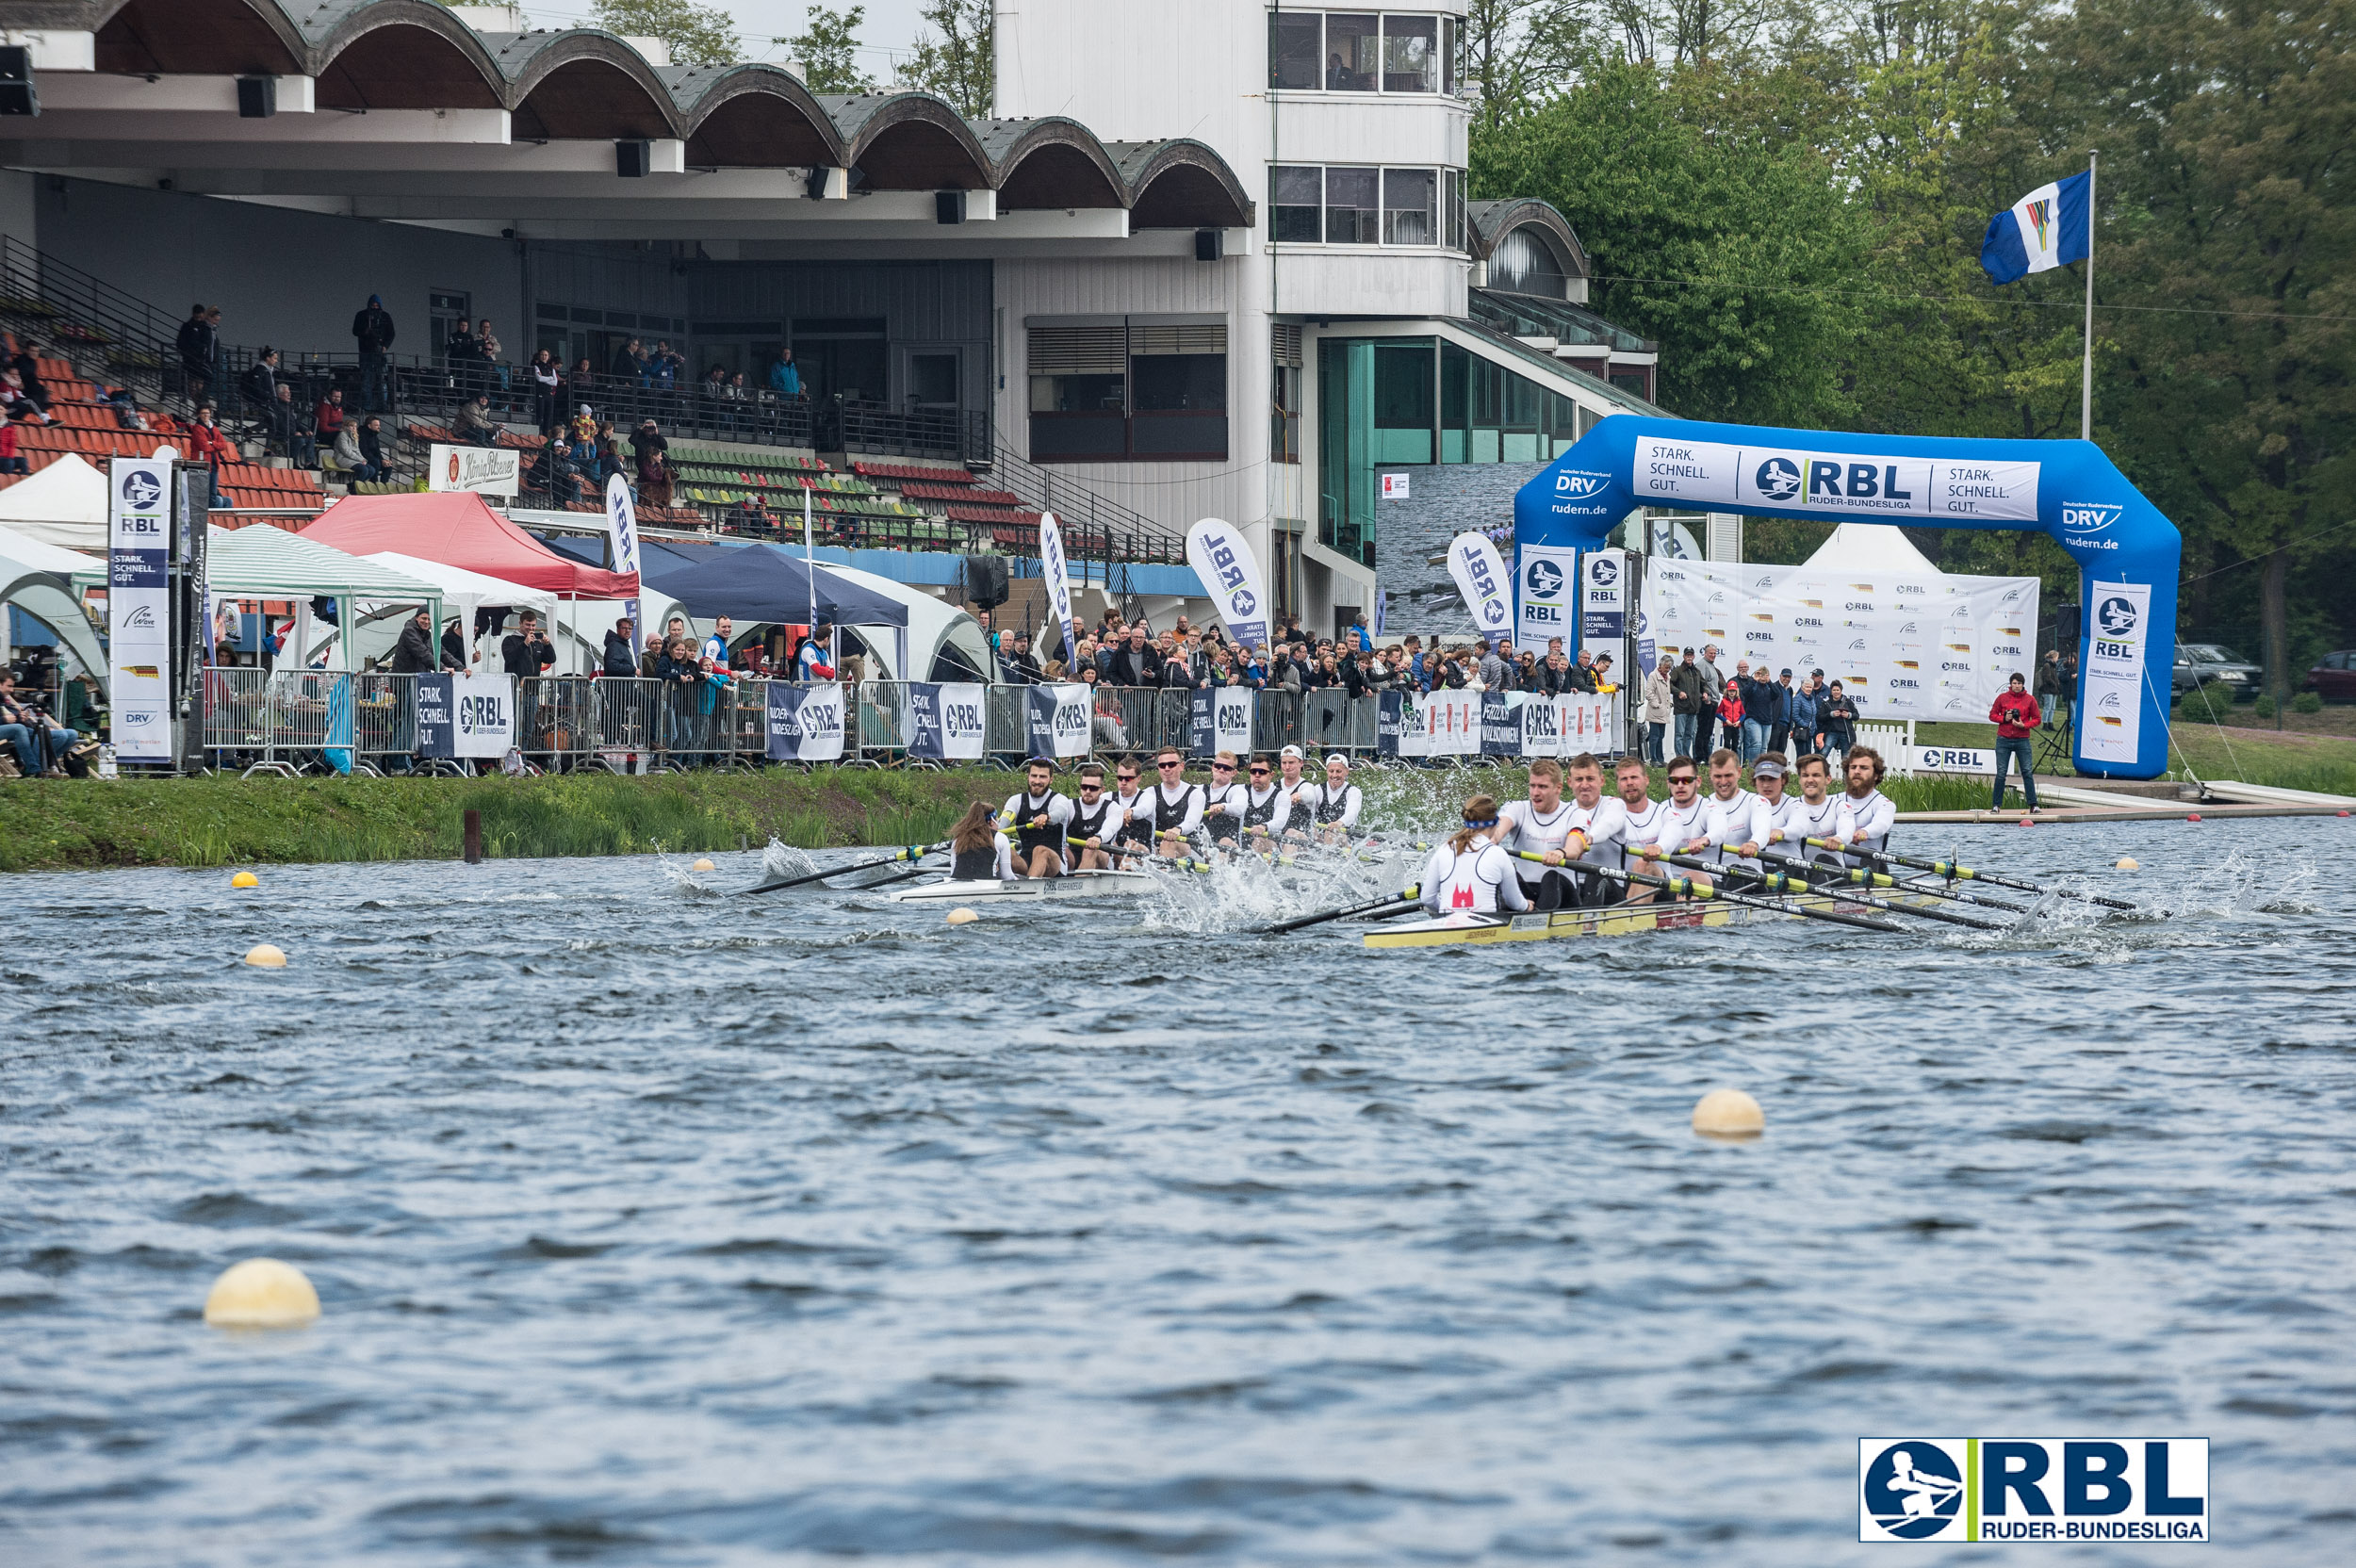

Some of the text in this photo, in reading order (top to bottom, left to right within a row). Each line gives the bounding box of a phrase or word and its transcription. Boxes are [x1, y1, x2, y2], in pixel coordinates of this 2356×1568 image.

[1652, 447, 1694, 461] STARK.
[1650, 463, 1710, 479] SCHNELL.
[1949, 468, 1993, 482] STARK.
[1556, 476, 1596, 494] DRV
[1650, 479, 1679, 492] GUT.
[1809, 461, 1911, 499] RBL
[1948, 484, 2009, 498] SCHNELL.
[1552, 503, 1608, 515] rudern.de
[1809, 497, 1911, 510] RUDER-BUNDESLIGA
[1948, 501, 1979, 514] GUT.
[2063, 509, 2107, 526] DRV
[122, 518, 160, 532] RBL
[2066, 537, 2119, 549] rudern.de
[115, 555, 145, 564] STARK.
[115, 564, 155, 573] SCHNELL.
[1591, 592, 1616, 600] RBL
[1526, 606, 1562, 621] RBL
[2095, 642, 2133, 658] RBL
[419, 687, 442, 703] STARK.
[419, 709, 450, 724] SCHNELL.
[476, 696, 506, 726] RBL
[813, 704, 840, 730] RBL
[957, 704, 982, 730] RBL
[1229, 705, 1246, 728] RBL
[126, 714, 149, 723] DRV
[1944, 751, 1983, 765] RBL
[1794, 860, 1812, 869] RBL
[1880, 854, 1897, 863] RBL
[1609, 868, 1628, 878] RBL
[1710, 864, 1728, 874] RBL
[1787, 905, 1802, 913] RBL
